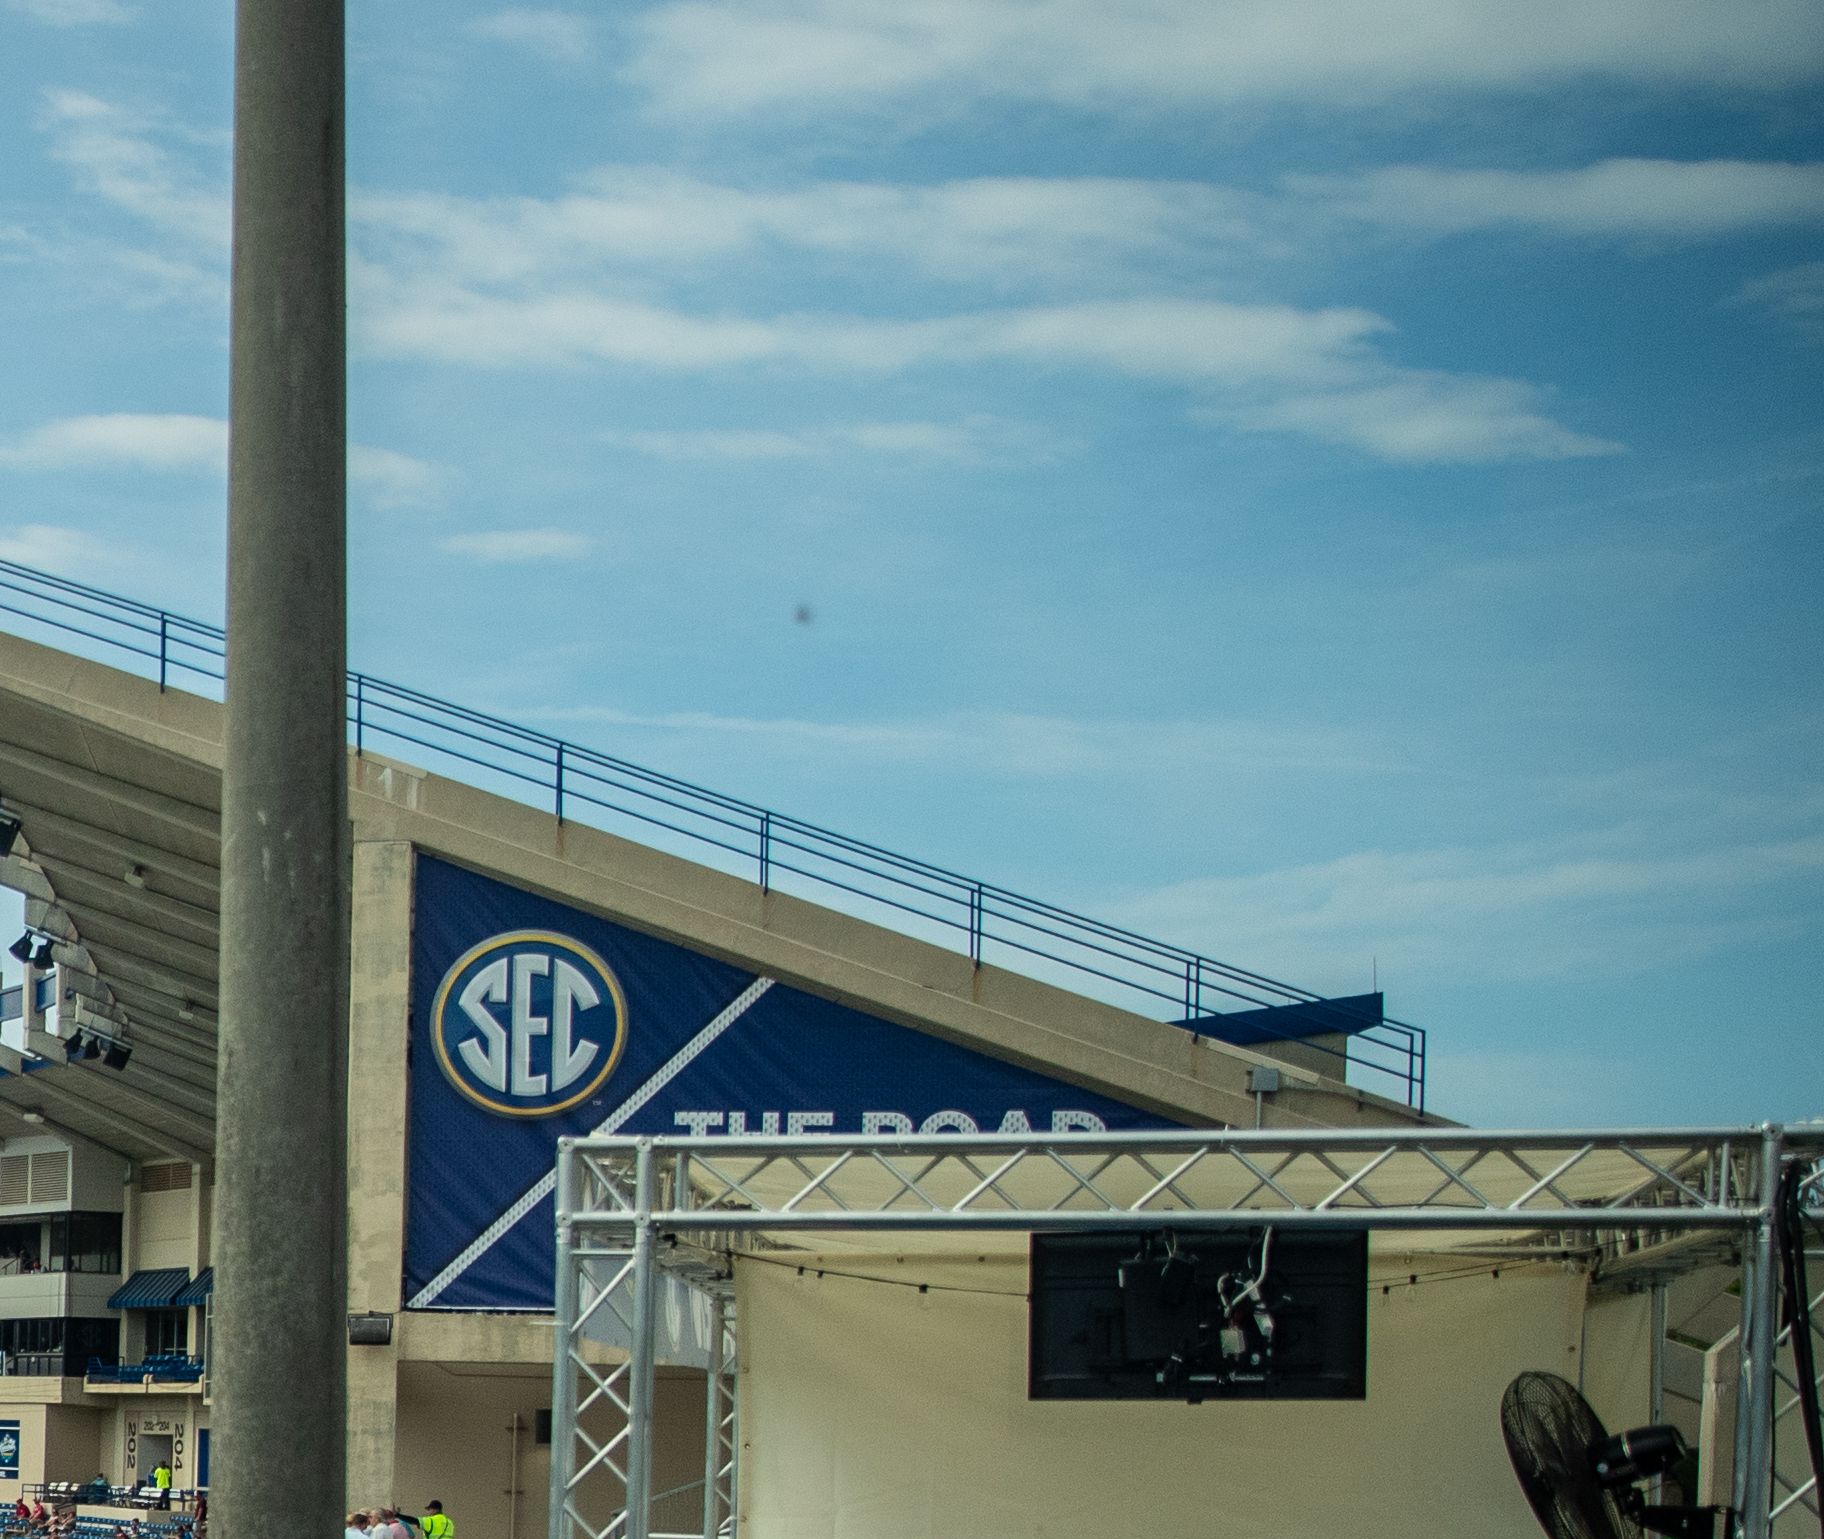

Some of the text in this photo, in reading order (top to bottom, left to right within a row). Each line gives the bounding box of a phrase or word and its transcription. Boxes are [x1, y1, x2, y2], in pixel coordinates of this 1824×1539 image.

[457, 953, 601, 1097] SEC
[127, 1422, 136, 1469] 202
[174, 1423, 184, 1471] 204
